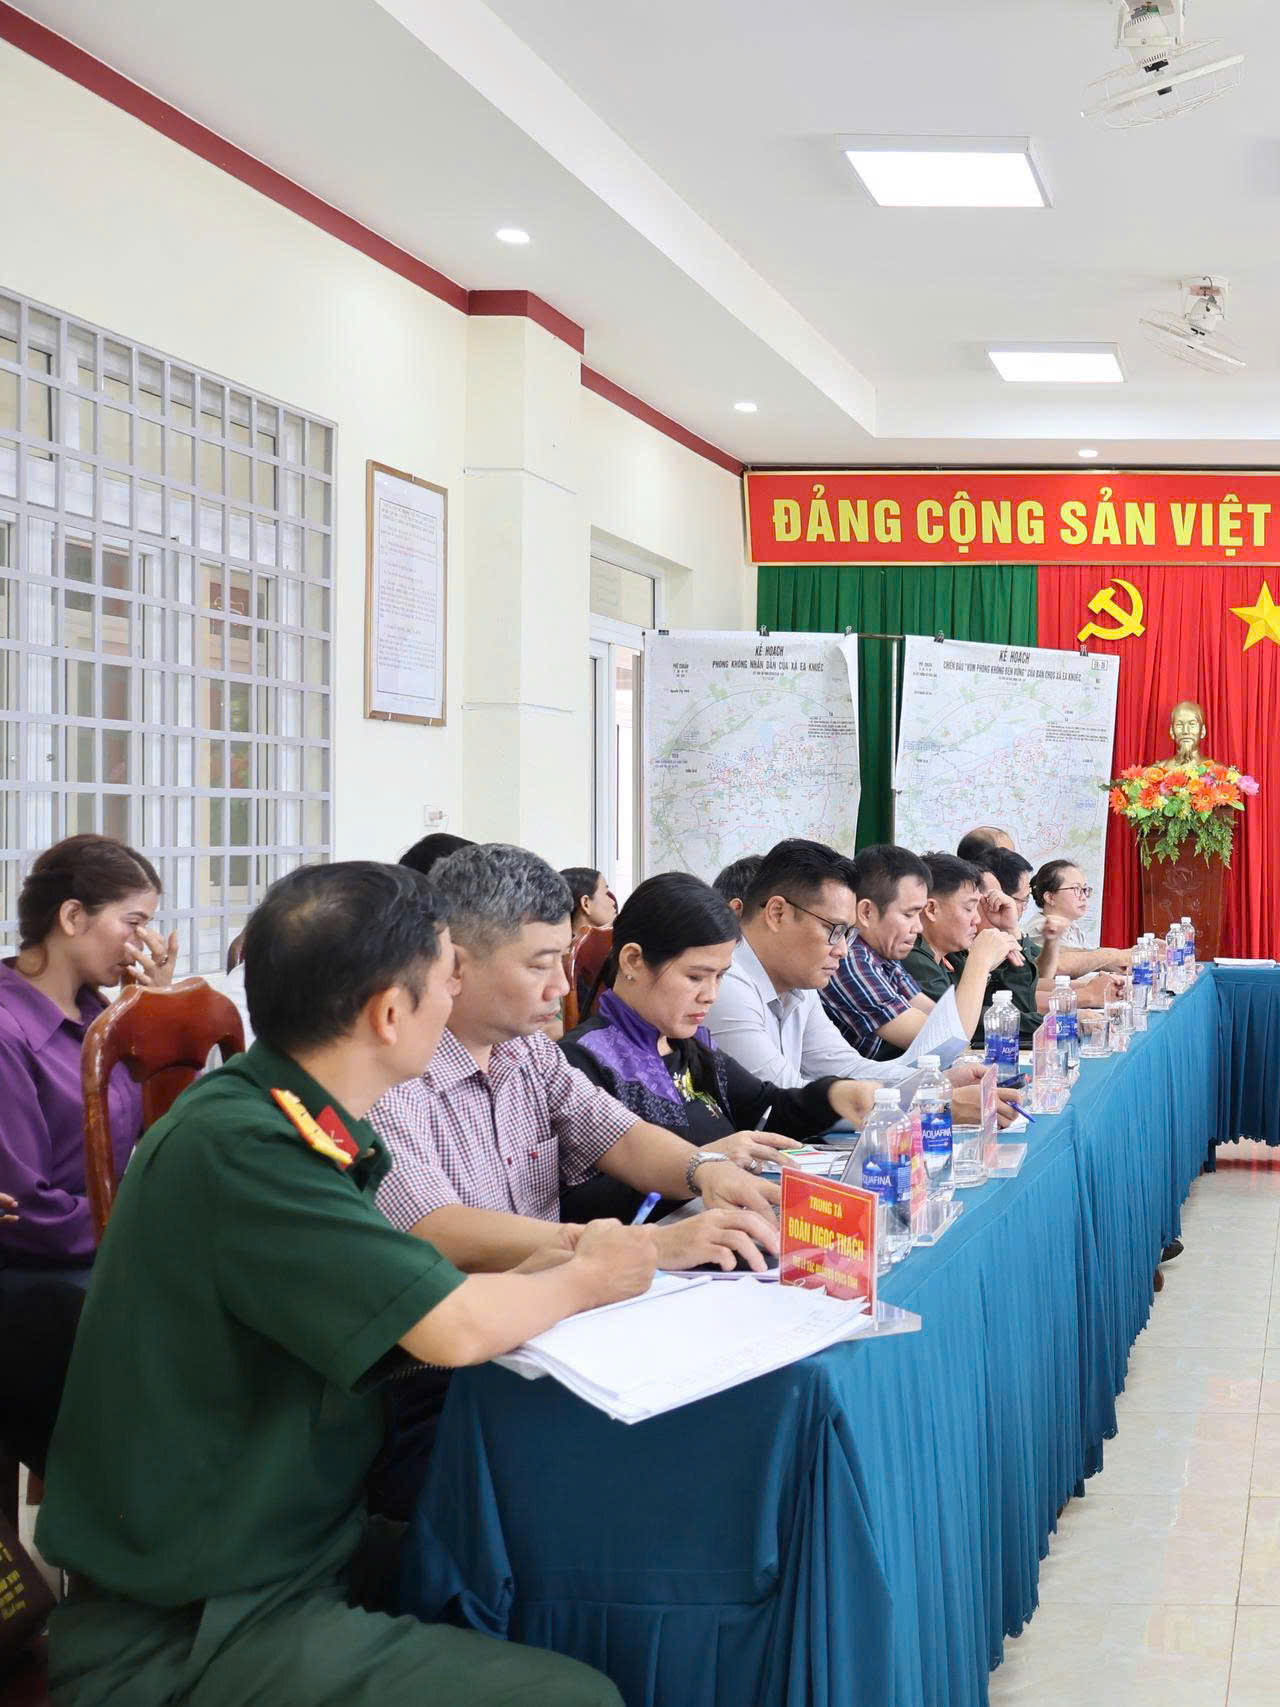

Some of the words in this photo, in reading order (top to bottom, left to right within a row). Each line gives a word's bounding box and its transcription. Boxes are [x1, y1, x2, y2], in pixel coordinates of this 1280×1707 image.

[773, 483, 902, 543] ĐẢNG
[916, 491, 1046, 554] CỘNG
[1060, 486, 1157, 547] SẢN
[1172, 493, 1272, 557] VIỆT
[809, 1195, 832, 1215] TRUNG
[833, 1202, 843, 1219] TÁ
[788, 1216, 811, 1244] ĐOÀN
